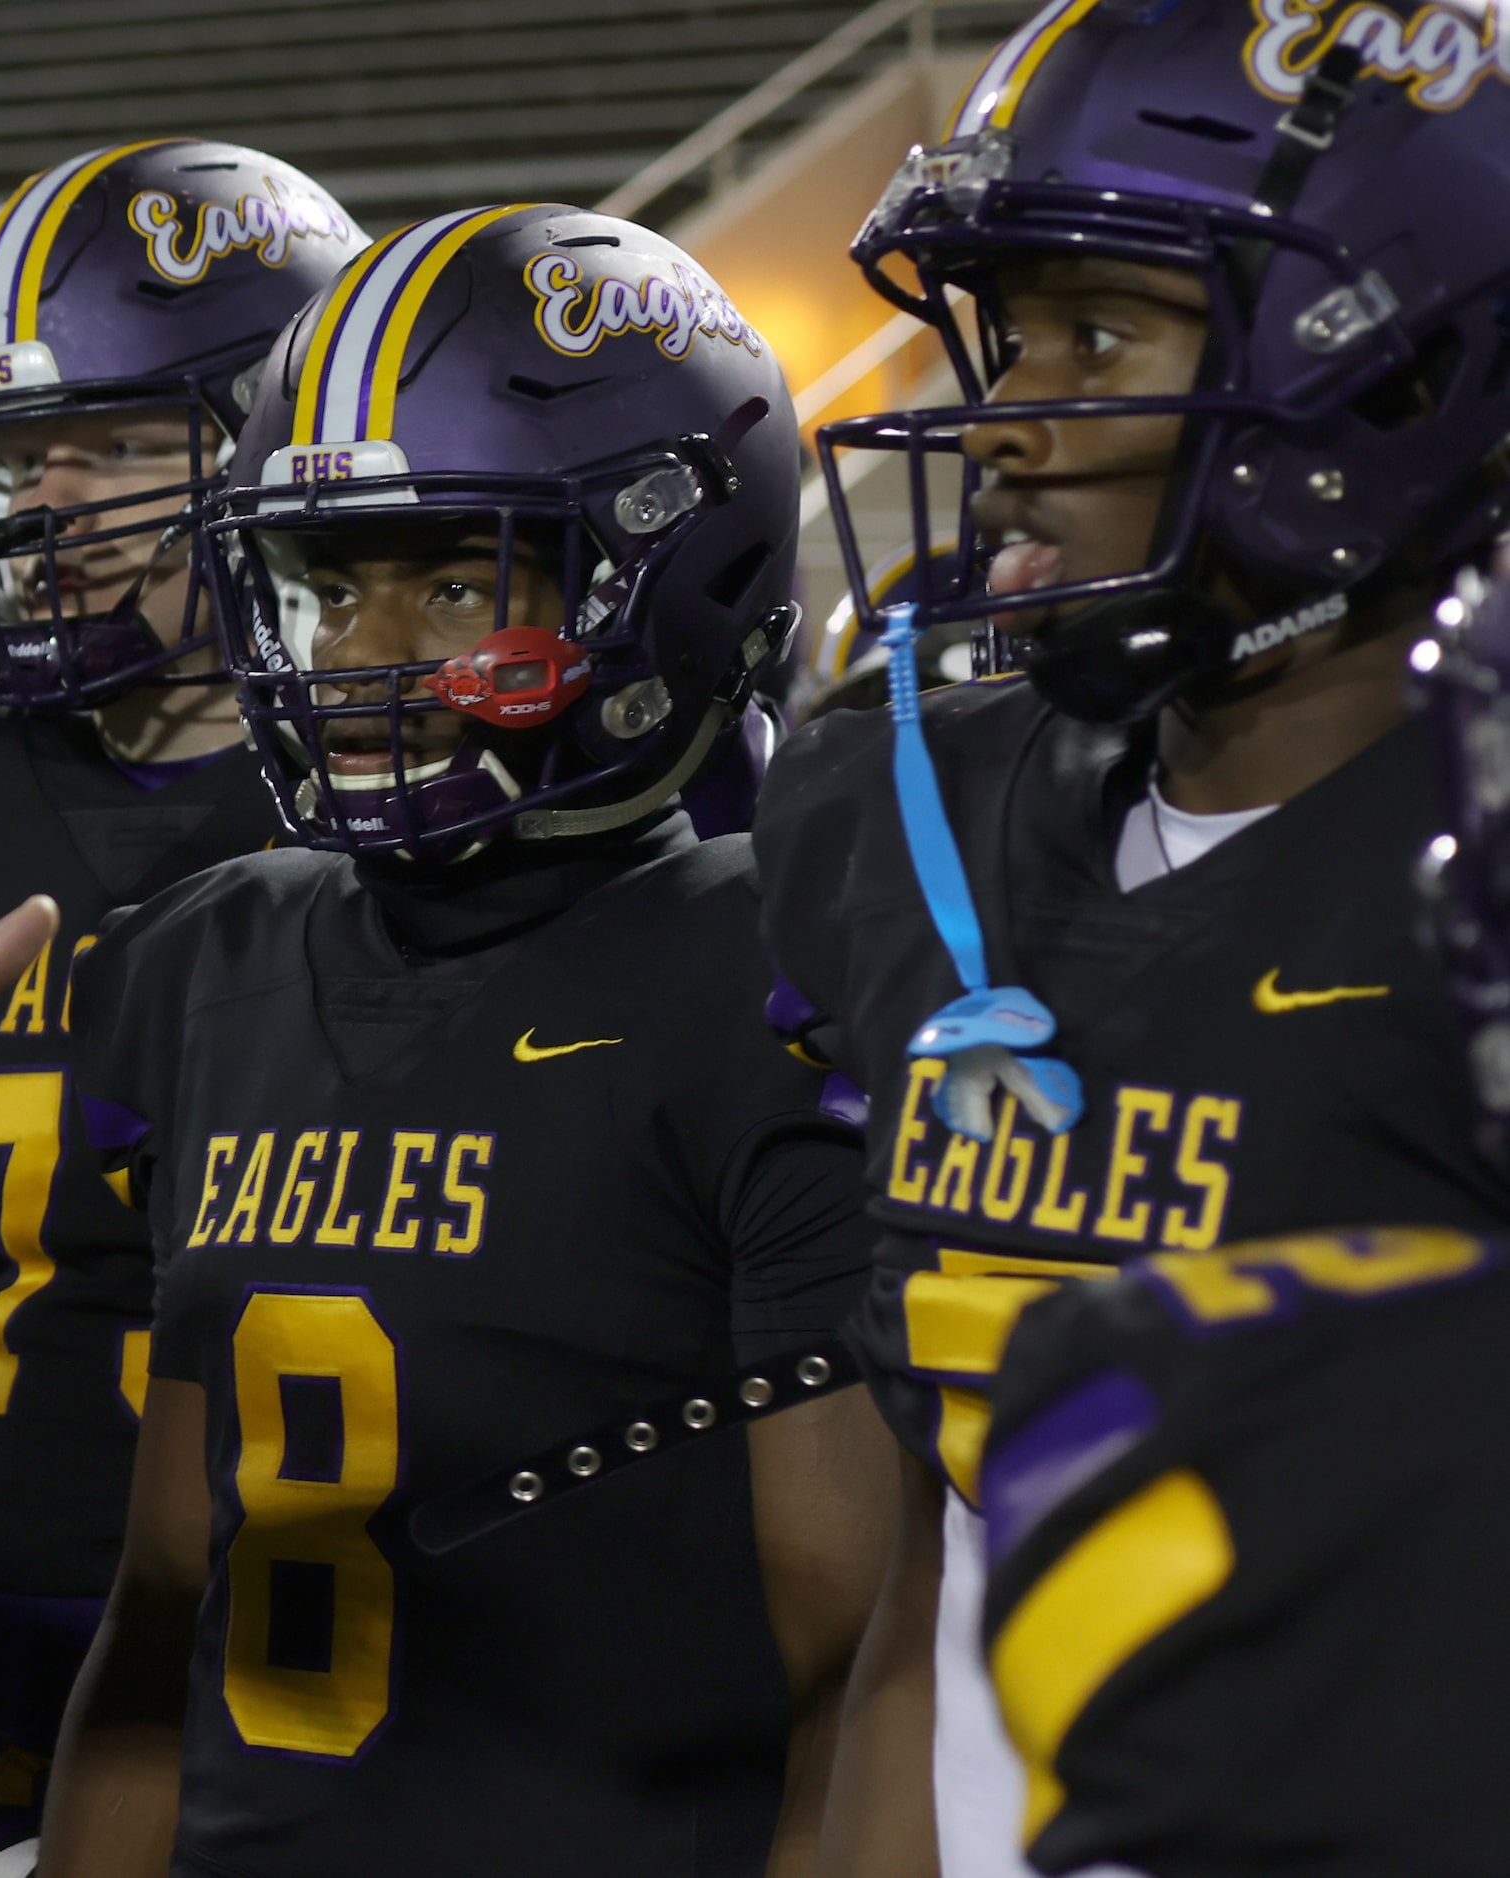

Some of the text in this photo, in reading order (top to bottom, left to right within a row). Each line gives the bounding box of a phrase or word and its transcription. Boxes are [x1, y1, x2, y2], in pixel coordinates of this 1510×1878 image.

[291, 449, 354, 484] RHS
[1230, 592, 1349, 662] ADAMS
[499, 700, 553, 716] SHOCK
[185, 1127, 497, 1258] EAGLES
[222, 1282, 409, 1767] 8
